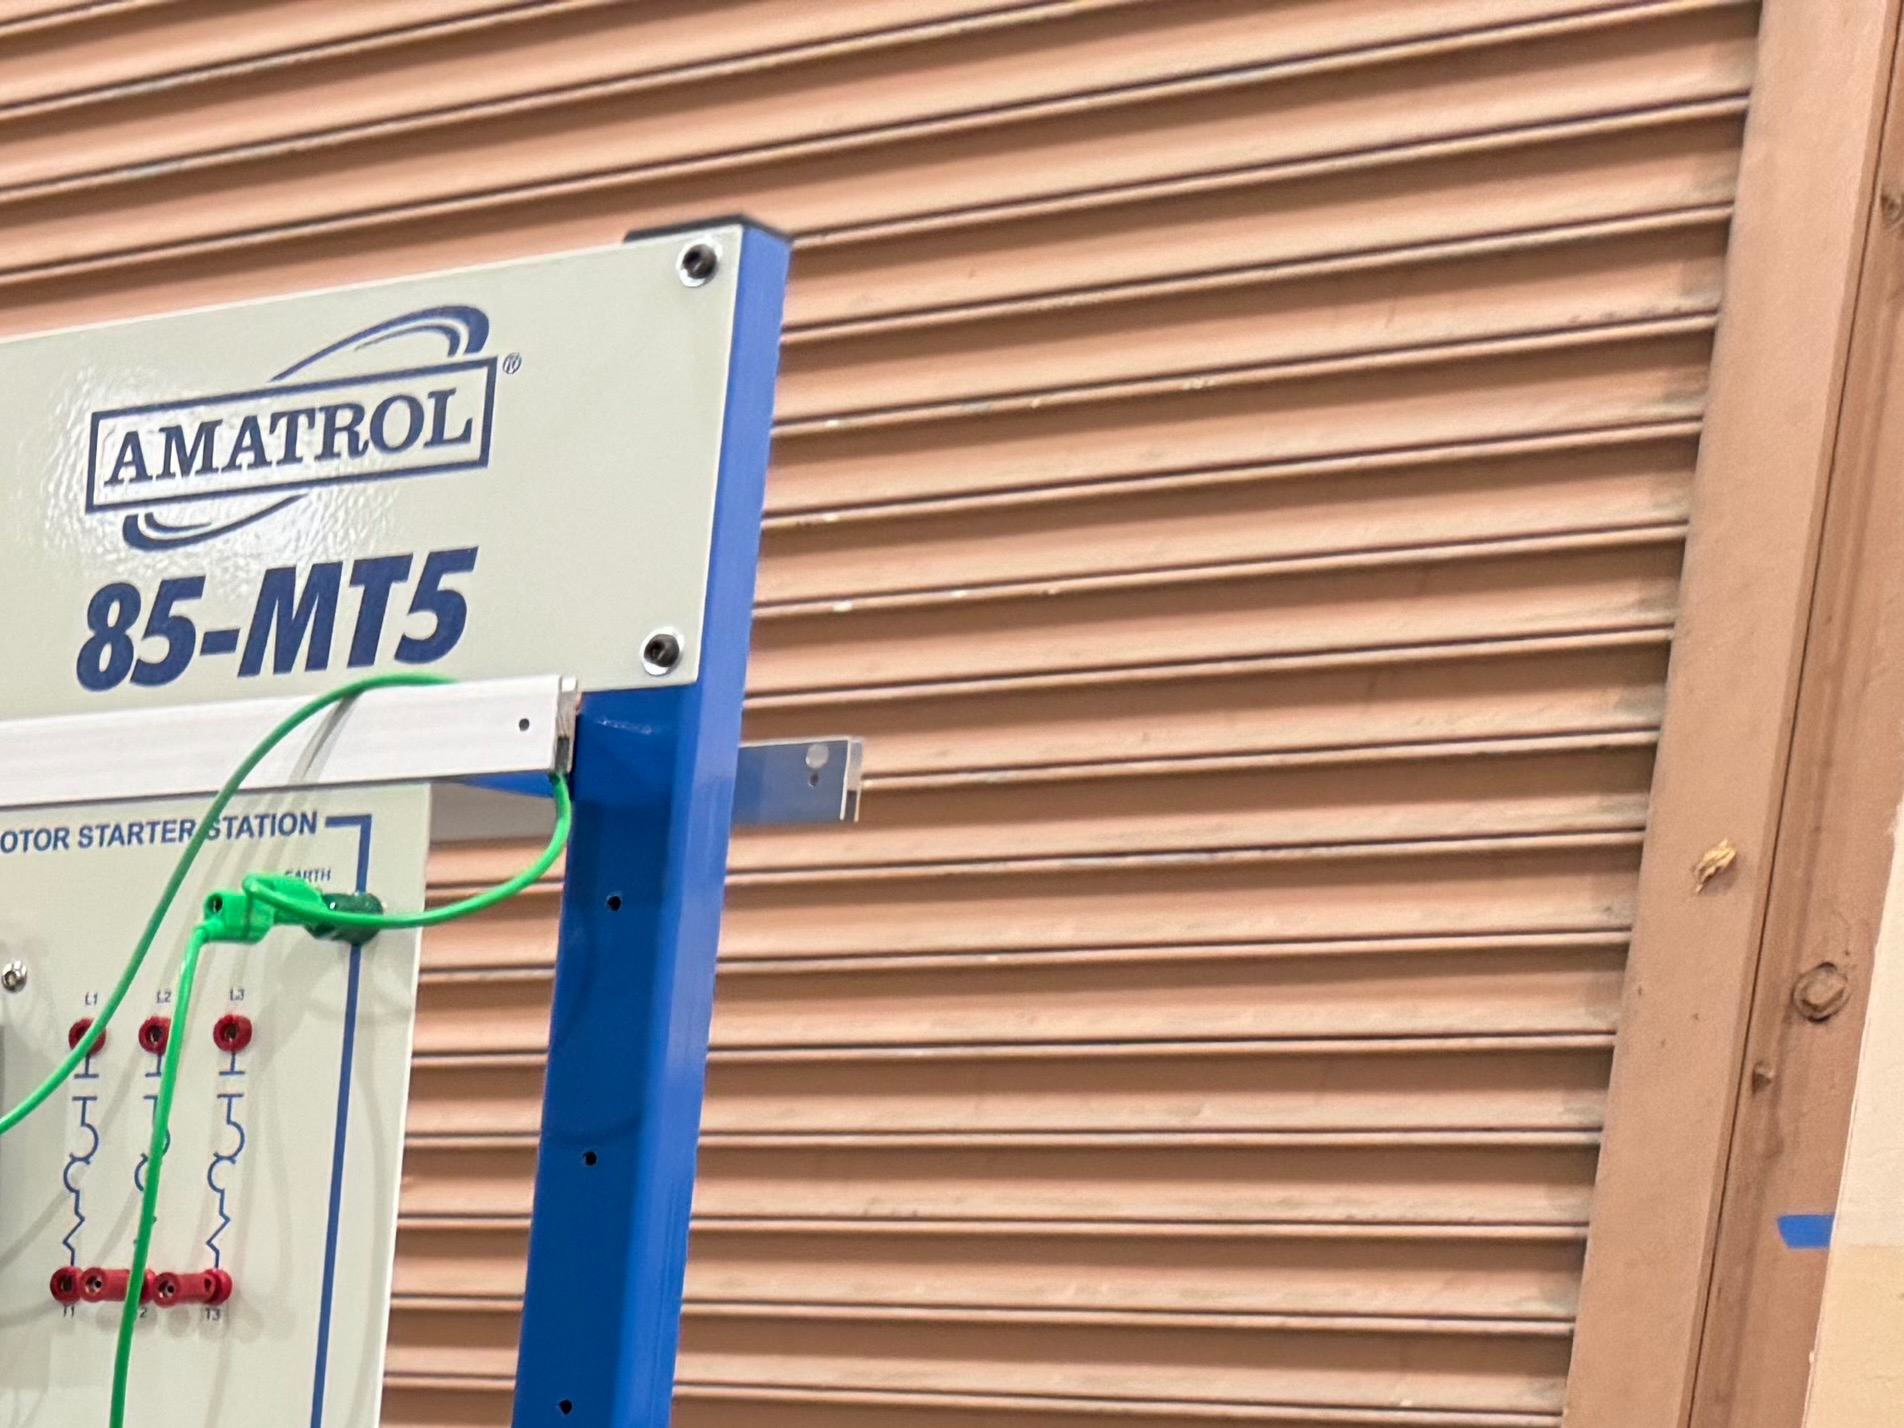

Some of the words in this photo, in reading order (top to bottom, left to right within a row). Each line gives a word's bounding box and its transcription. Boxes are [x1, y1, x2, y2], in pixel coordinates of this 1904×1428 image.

[104, 388, 472, 488] AMATROL
[76, 546, 479, 692] 85-MT5
[78, 818, 196, 848] STARTER
[208, 811, 318, 840] STATION
[155, 990, 172, 1004] L2
